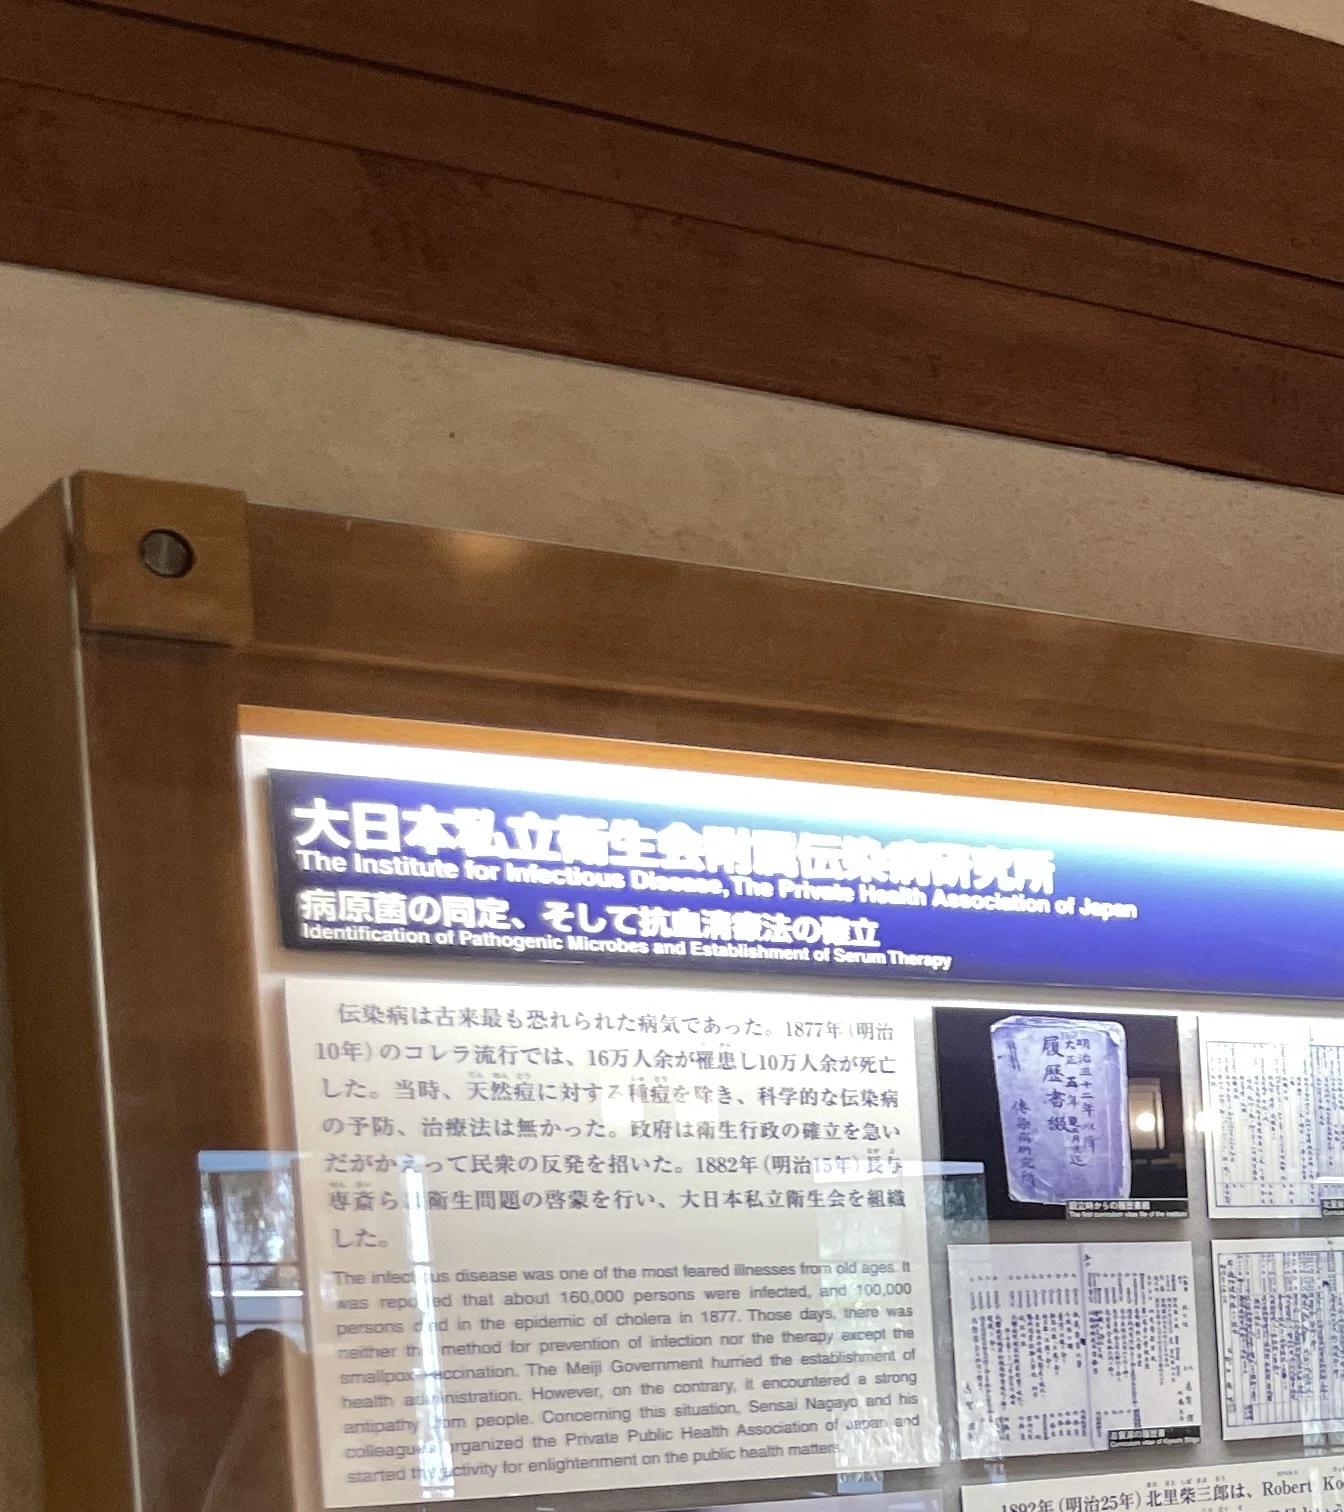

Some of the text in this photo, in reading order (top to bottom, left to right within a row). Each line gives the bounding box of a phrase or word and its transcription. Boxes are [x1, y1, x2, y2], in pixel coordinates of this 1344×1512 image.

[296, 849, 1138, 922] The Institute for Infectious Disease, The Private Health Association of Japan
[302, 923, 953, 971] Identification of Pathogenic Microbes and Establishment of Serum Therapy
[332, 1228, 390, 1248] した。
[331, 1270, 365, 1285] The
[455, 1270, 517, 1282] disease
[522, 1269, 554, 1280] was
[559, 1269, 588, 1280] one
[593, 1265, 608, 1279] of
[612, 1266, 636, 1279] the
[641, 1265, 678, 1278] most
[682, 1263, 729, 1277] feared
[733, 1263, 795, 1276] illnesses
[799, 1259, 831, 1274] from
[835, 1260, 856, 1274] old
[336, 1322, 405, 1337] persons
[457, 1315, 471, 1330] in
[479, 1317, 505, 1330] the
[513, 1316, 585, 1329] epidemic
[591, 1312, 607, 1326] of
[615, 1312, 671, 1325] cholera
[679, 1311, 692, 1323] in
[746, 1308, 792, 1321] Those
[799, 1307, 836, 1322] days,
[885, 1306, 913, 1317] was
[524, 1362, 557, 1376] The
[610, 1358, 702, 1372] Government
[711, 1354, 762, 1368] hurried
[769, 1353, 792, 1366] the
[800, 1349, 895, 1365] establishment
[902, 1347, 915, 1360] of
